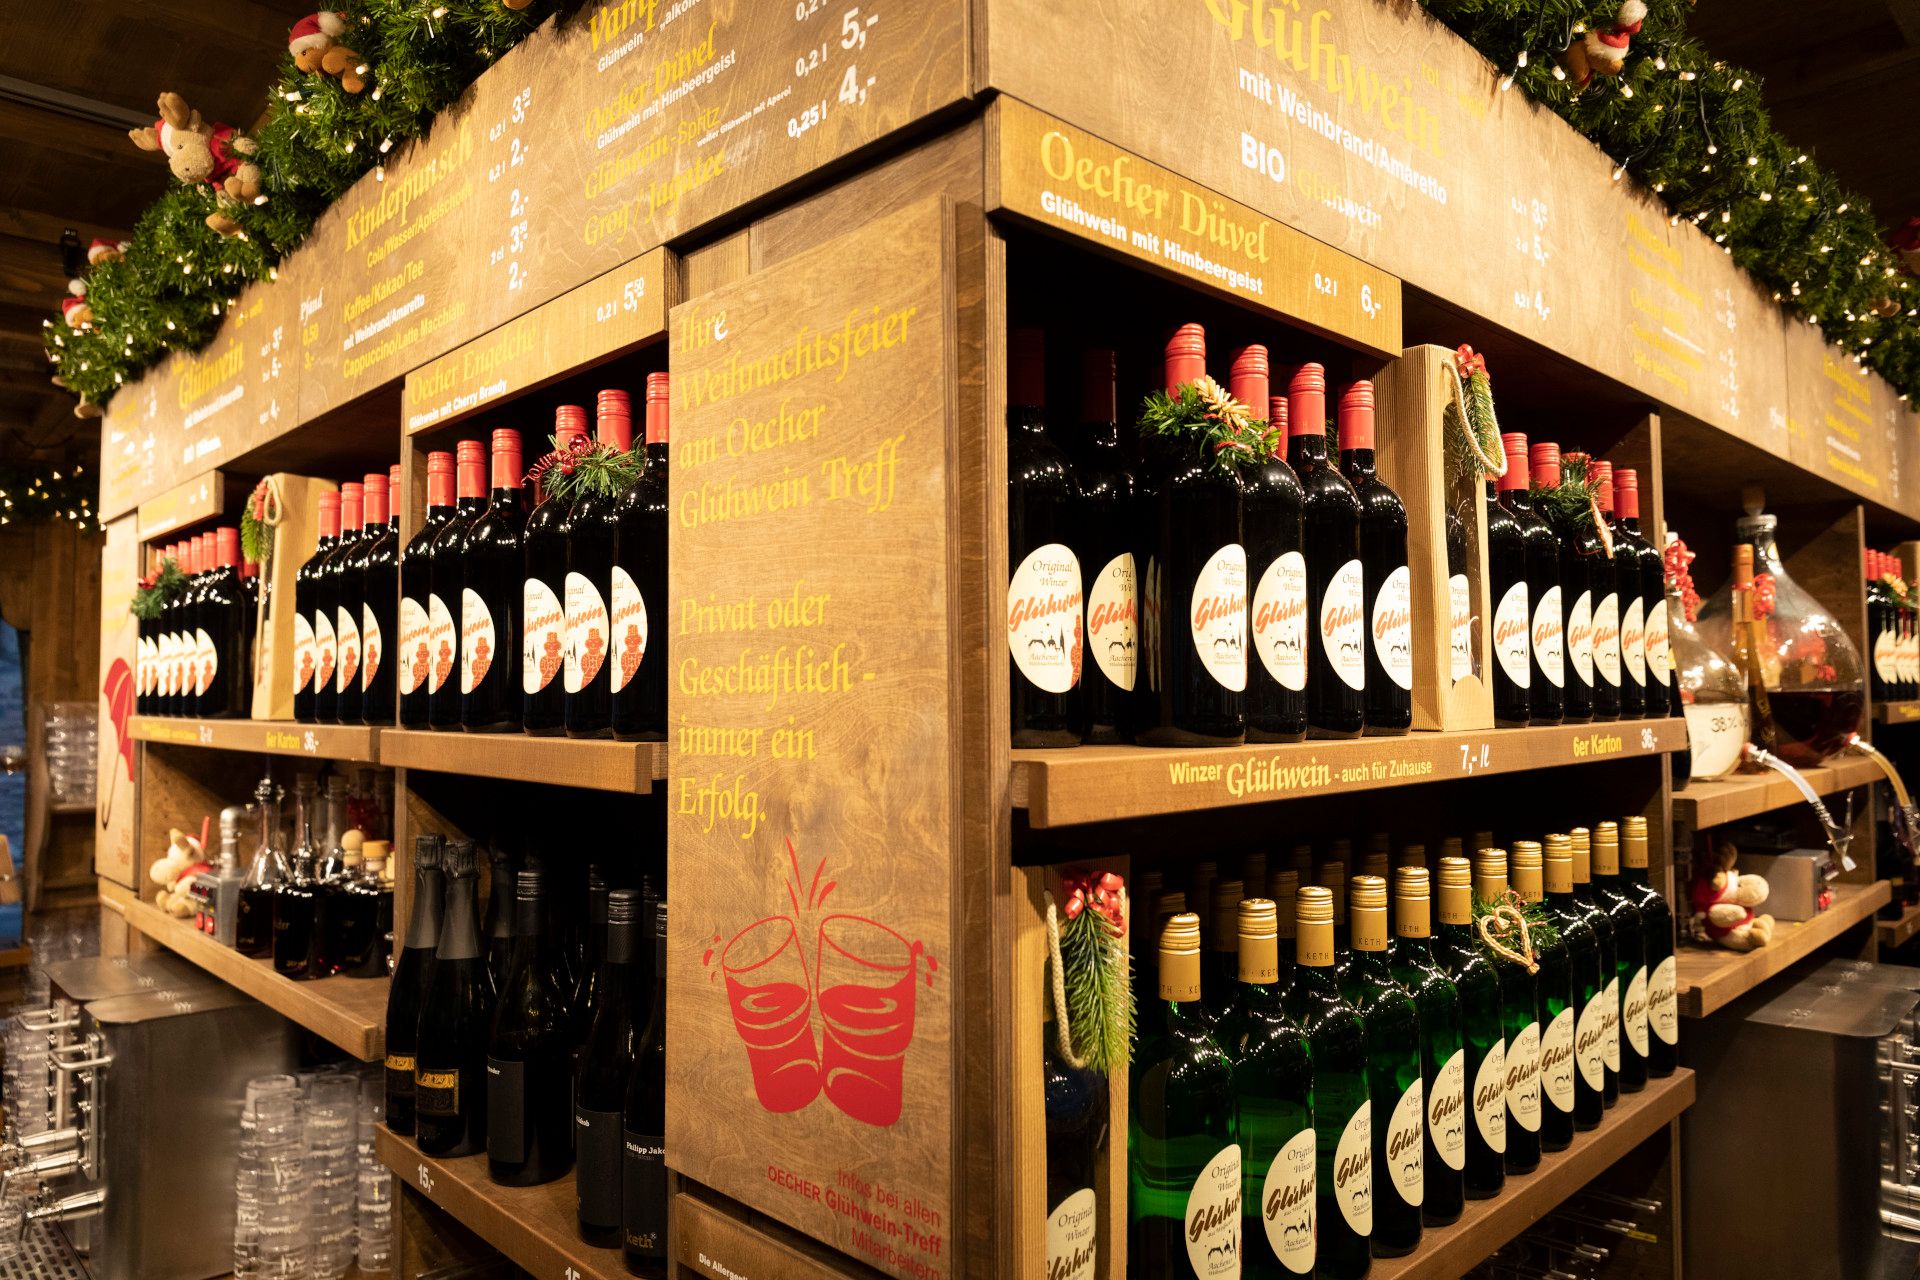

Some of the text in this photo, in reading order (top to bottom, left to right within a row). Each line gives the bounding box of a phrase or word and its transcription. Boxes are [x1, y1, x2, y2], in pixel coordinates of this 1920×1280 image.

[598, 32, 643, 73] Glühwein
[796, 49, 818, 77] 0,2
[841, 7, 878, 50] 5,-
[585, 20, 717, 139] Oecher Düvel
[597, 49, 736, 150] Glühwein mit Himbeergeist
[788, 104, 819, 138] 0,25
[839, 64, 877, 106] 4,-
[510, 138, 528, 167] 2,-
[1239, 67, 1273, 105] mit
[1277, 83, 1447, 205] Weinbrand/Amaretto
[1240, 132, 1285, 183] BIO
[345, 116, 474, 253] Kinderpunsch
[510, 188, 528, 218] 2,-
[1040, 130, 1271, 265] Oecher Düvel
[584, 201, 631, 246] Grog
[508, 261, 527, 290] 2,-
[1040, 190, 1128, 243] Glühwein
[1131, 229, 1160, 255] mit
[1163, 240, 1264, 296] Himbeergeist
[1314, 272, 1331, 296] 0,2
[1360, 284, 1382, 320] 6,-
[343, 260, 425, 324] Kaffee/Kakao/Tee
[597, 303, 612, 322] 0,2
[680, 305, 729, 353] Ihre
[411, 359, 457, 406] Oecher
[679, 304, 917, 412] Weihnachtsfeier
[679, 396, 827, 471] am Oecher
[679, 434, 907, 529] Glühwein Treff
[680, 579, 832, 635] Privat oder
[680, 642, 854, 713] Geschäftlich
[677, 714, 817, 760] immer ein
[1573, 737, 1589, 757] 6er
[1591, 735, 1622, 755] Karton
[1169, 761, 1223, 785] Winzer
[1226, 755, 1332, 798] Glühwein
[1342, 764, 1369, 783] auch
[1372, 761, 1388, 780] für
[1389, 759, 1432, 778] Zuhause
[677, 772, 767, 840] Erfolg.
[1306, 952, 1330, 960] KETH
[1358, 937, 1381, 946] KETH
[626, 1141, 647, 1155] Philipp
[417, 1163, 435, 1193] 15,-
[837, 1167, 941, 1228] Infos bei allen
[767, 1165, 941, 1257] OECHER Glühwein-Treff
[699, 1252, 711, 1267] Die
[851, 1227, 941, 1280] Mitarbeitern
